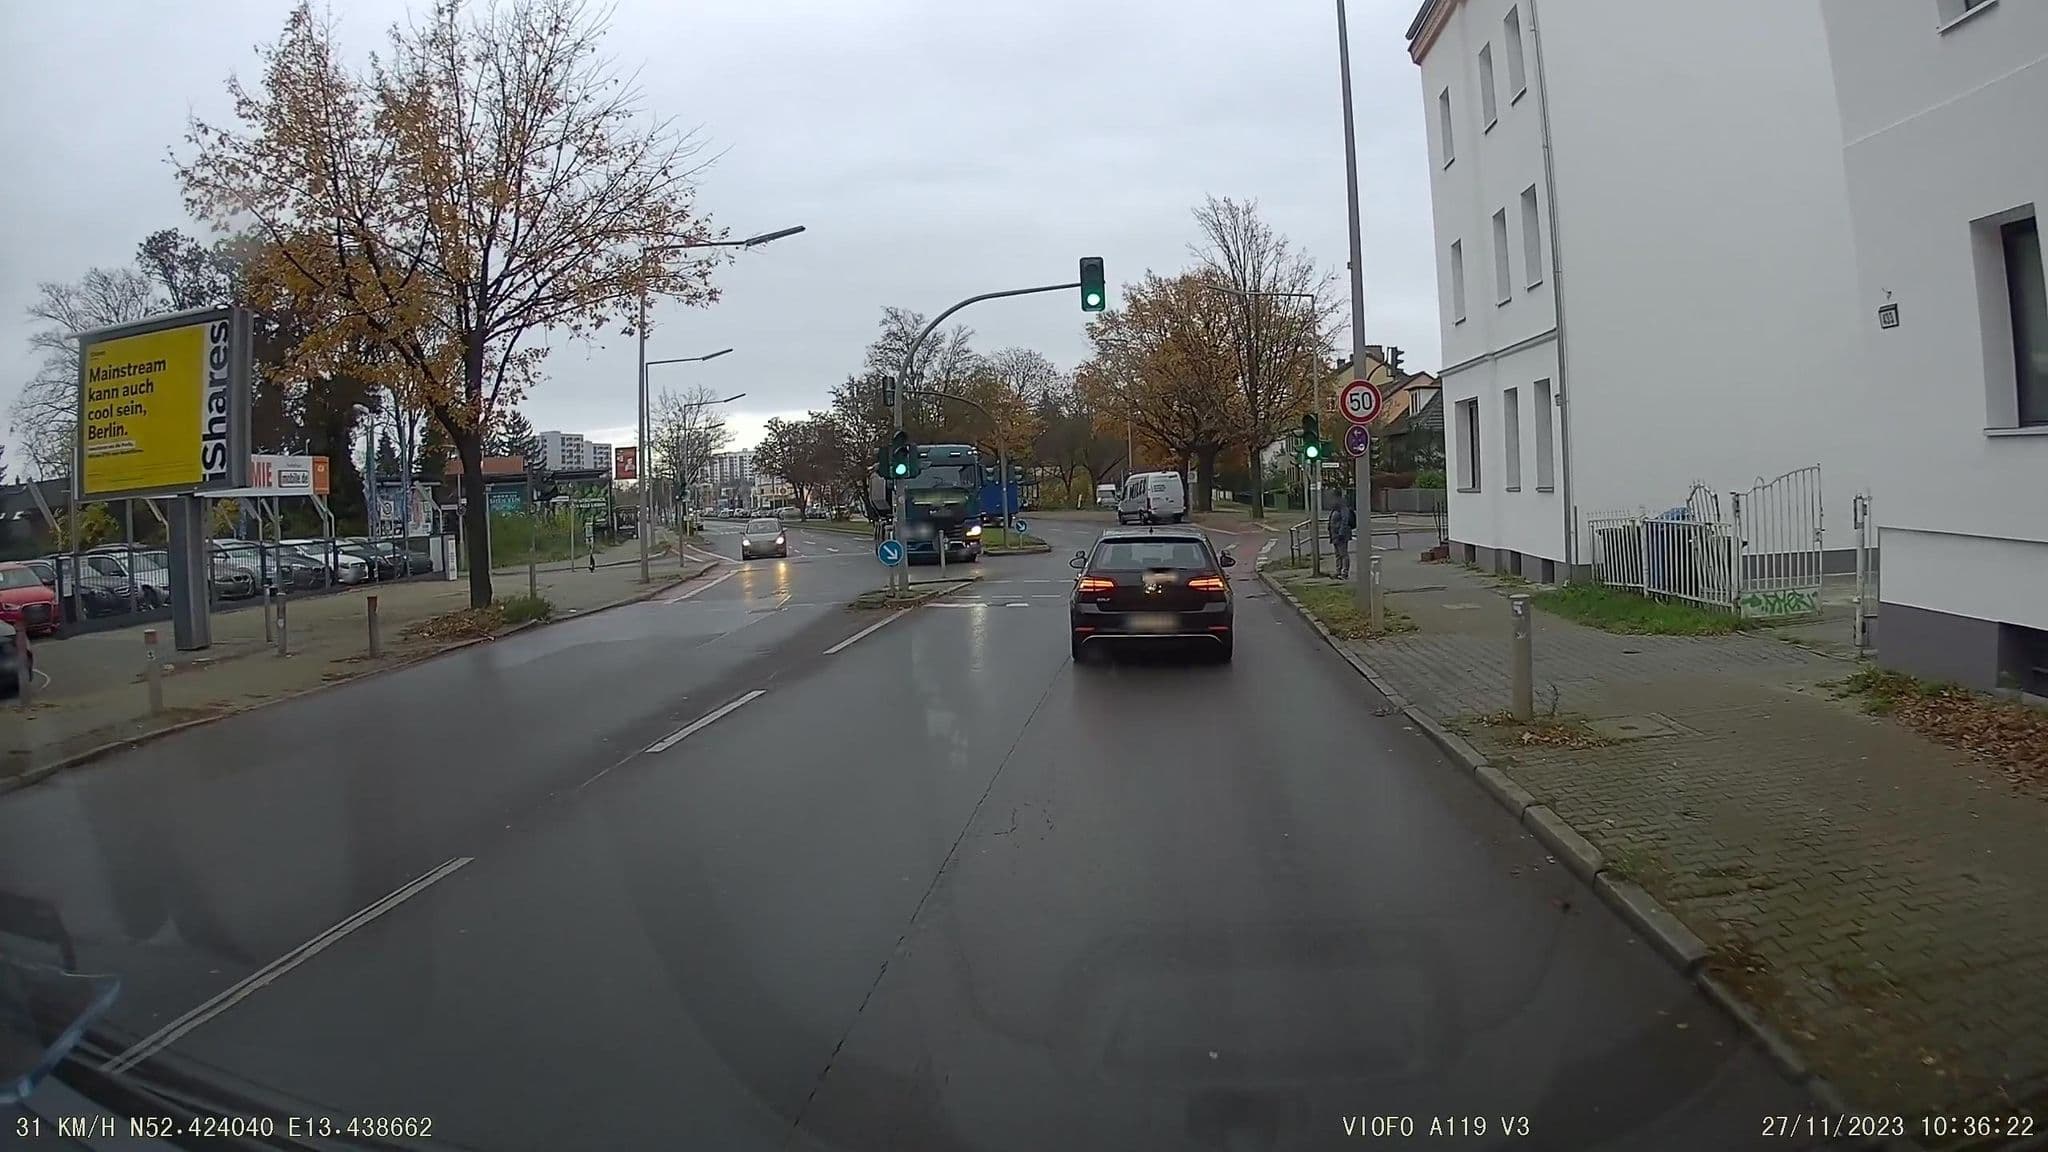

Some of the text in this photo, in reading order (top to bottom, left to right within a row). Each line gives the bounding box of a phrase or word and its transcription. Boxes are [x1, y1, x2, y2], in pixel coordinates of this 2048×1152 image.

[89, 358, 166, 383] Mainstream
[88, 380, 154, 402] kann auch
[202, 321, 229, 482] iShares
[1350, 391, 1373, 411] 50
[88, 399, 147, 421] cool sein,
[88, 421, 128, 440] Berlin.
